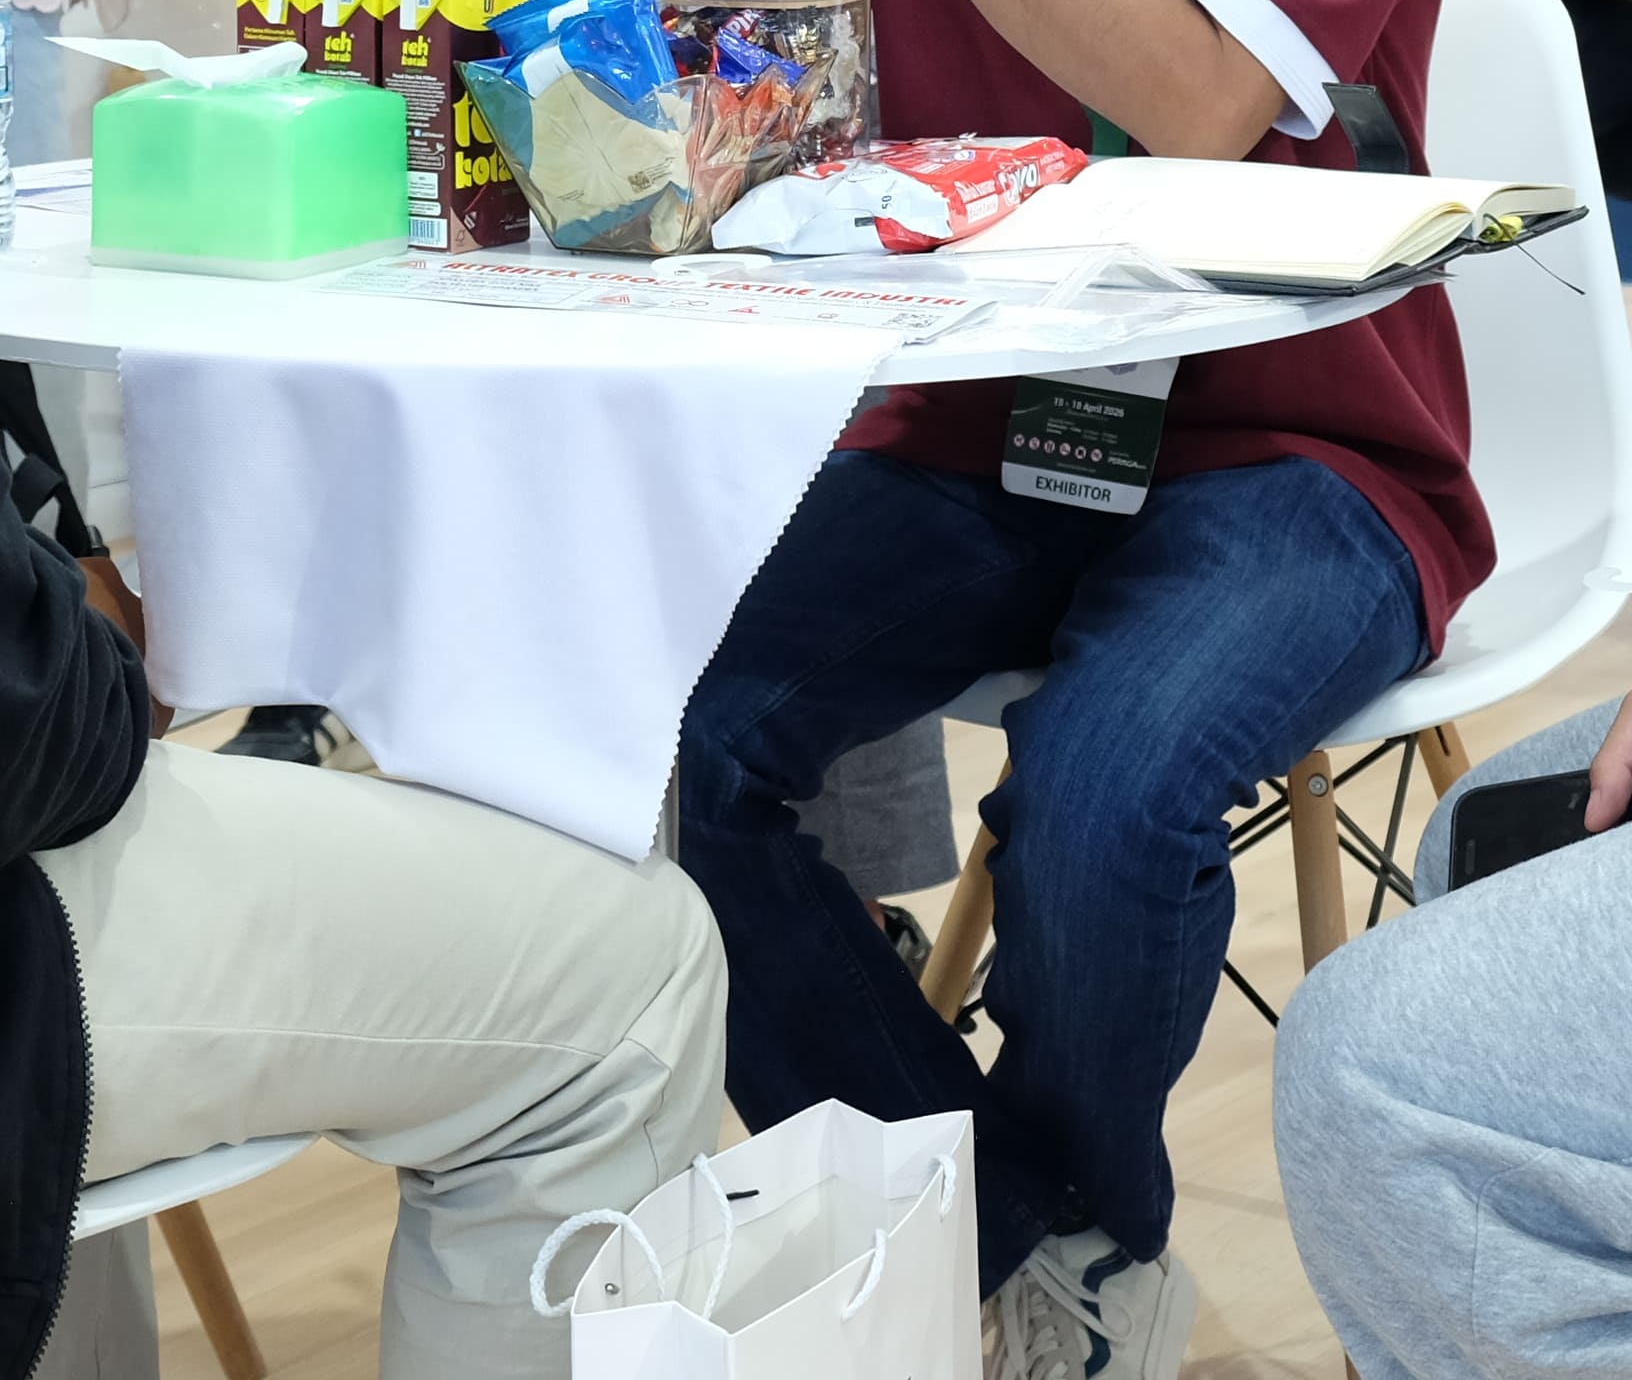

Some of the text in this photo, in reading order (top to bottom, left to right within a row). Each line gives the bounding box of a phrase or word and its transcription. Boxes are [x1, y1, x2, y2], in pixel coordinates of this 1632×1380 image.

[454, 151, 515, 190] kota
[704, 280, 818, 297] TEXTILE
[818, 289, 968, 307] INDUSTRI
[1082, 403, 1103, 415] April
[1035, 475, 1112, 503] EXHIBITOR
